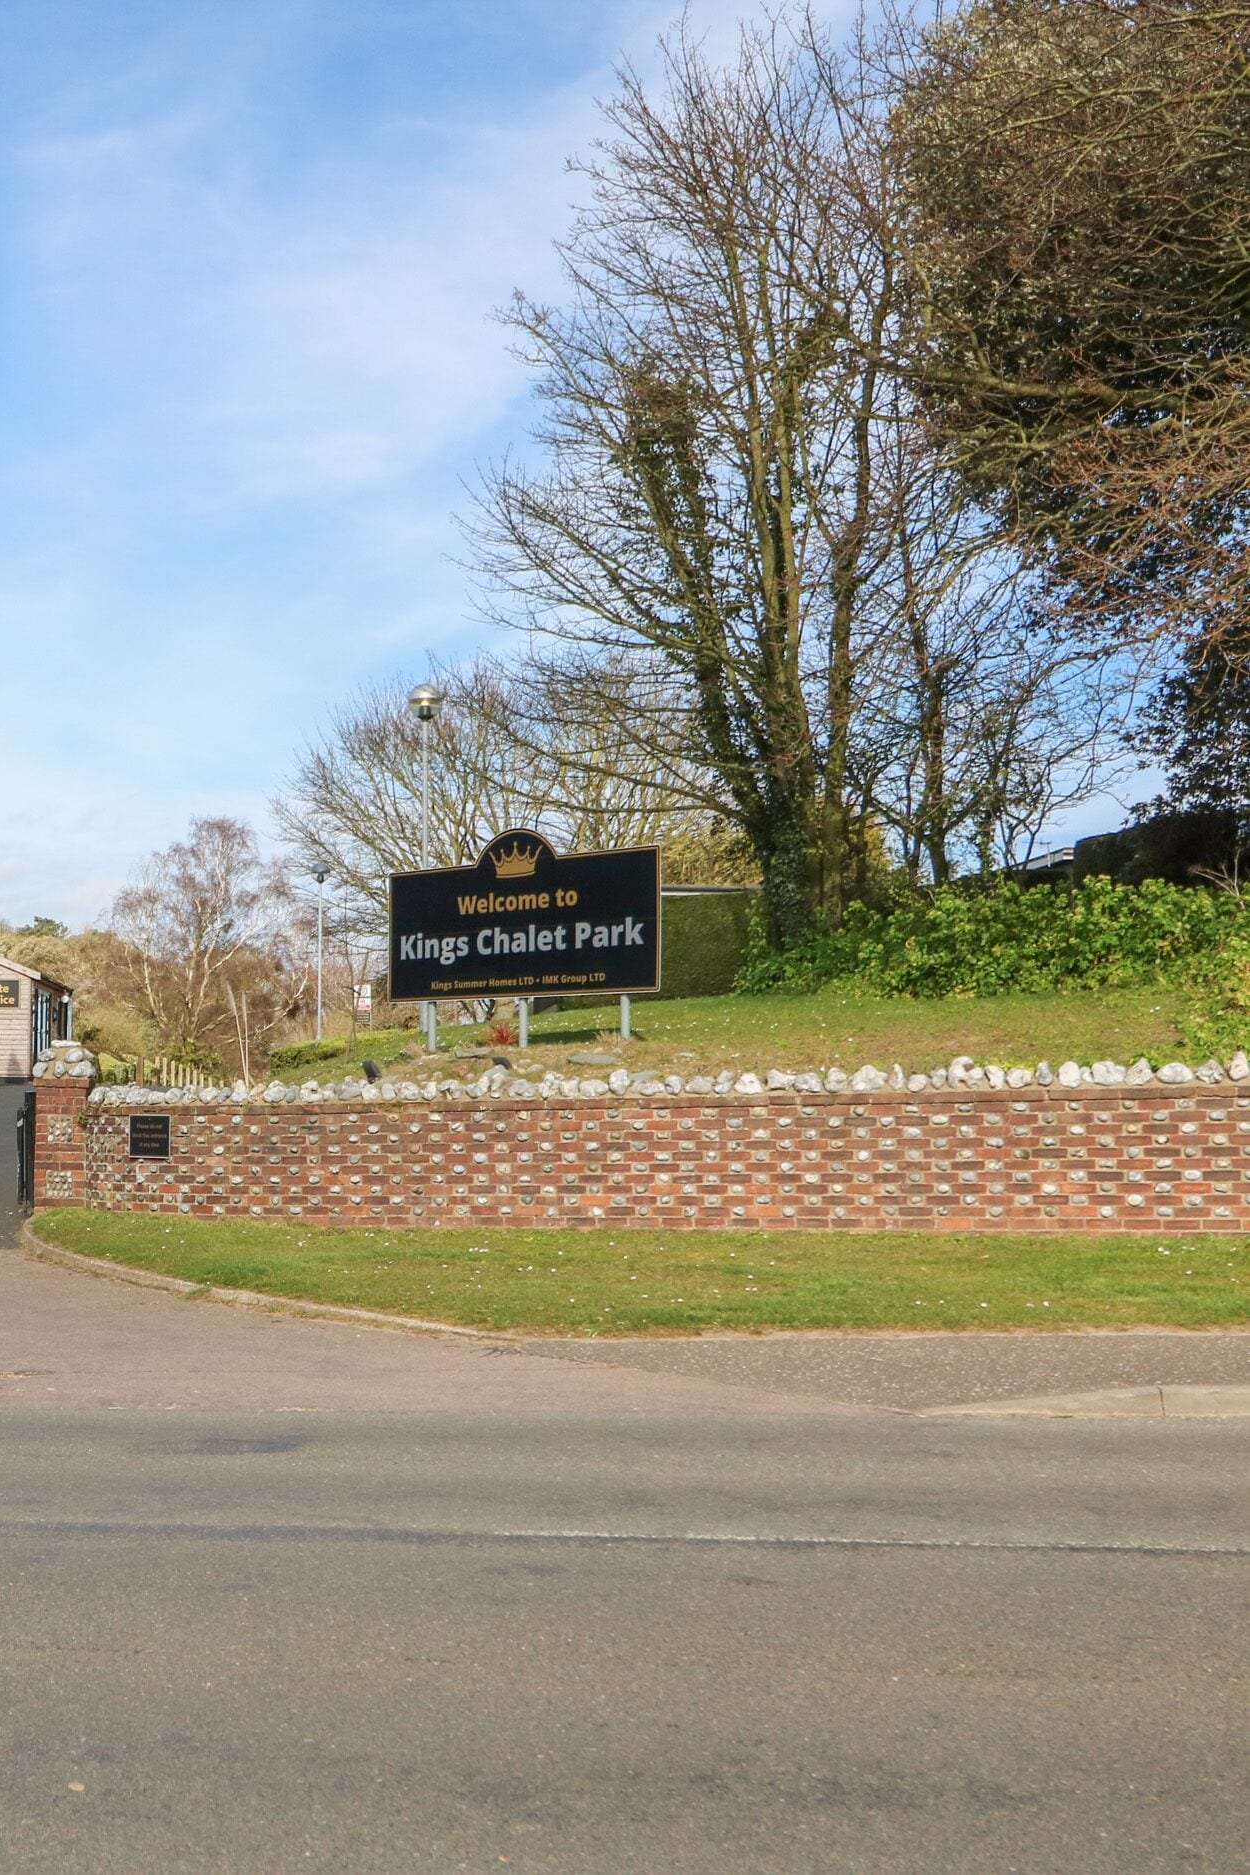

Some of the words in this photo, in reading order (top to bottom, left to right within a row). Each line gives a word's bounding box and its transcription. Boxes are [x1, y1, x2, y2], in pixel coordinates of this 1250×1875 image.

[457, 892, 549, 915] Welcome
[555, 888, 578, 907] to
[400, 932, 469, 965] Kings
[476, 924, 567, 956] Chalet
[574, 916, 645, 949] Park
[431, 980, 452, 991] Kings
[454, 979, 487, 989] Summer
[489, 978, 517, 987] Homes
[518, 977, 534, 986] LTD
[542, 975, 559, 985] IMK
[561, 974, 587, 985] Group
[589, 972, 606, 982] LTD
